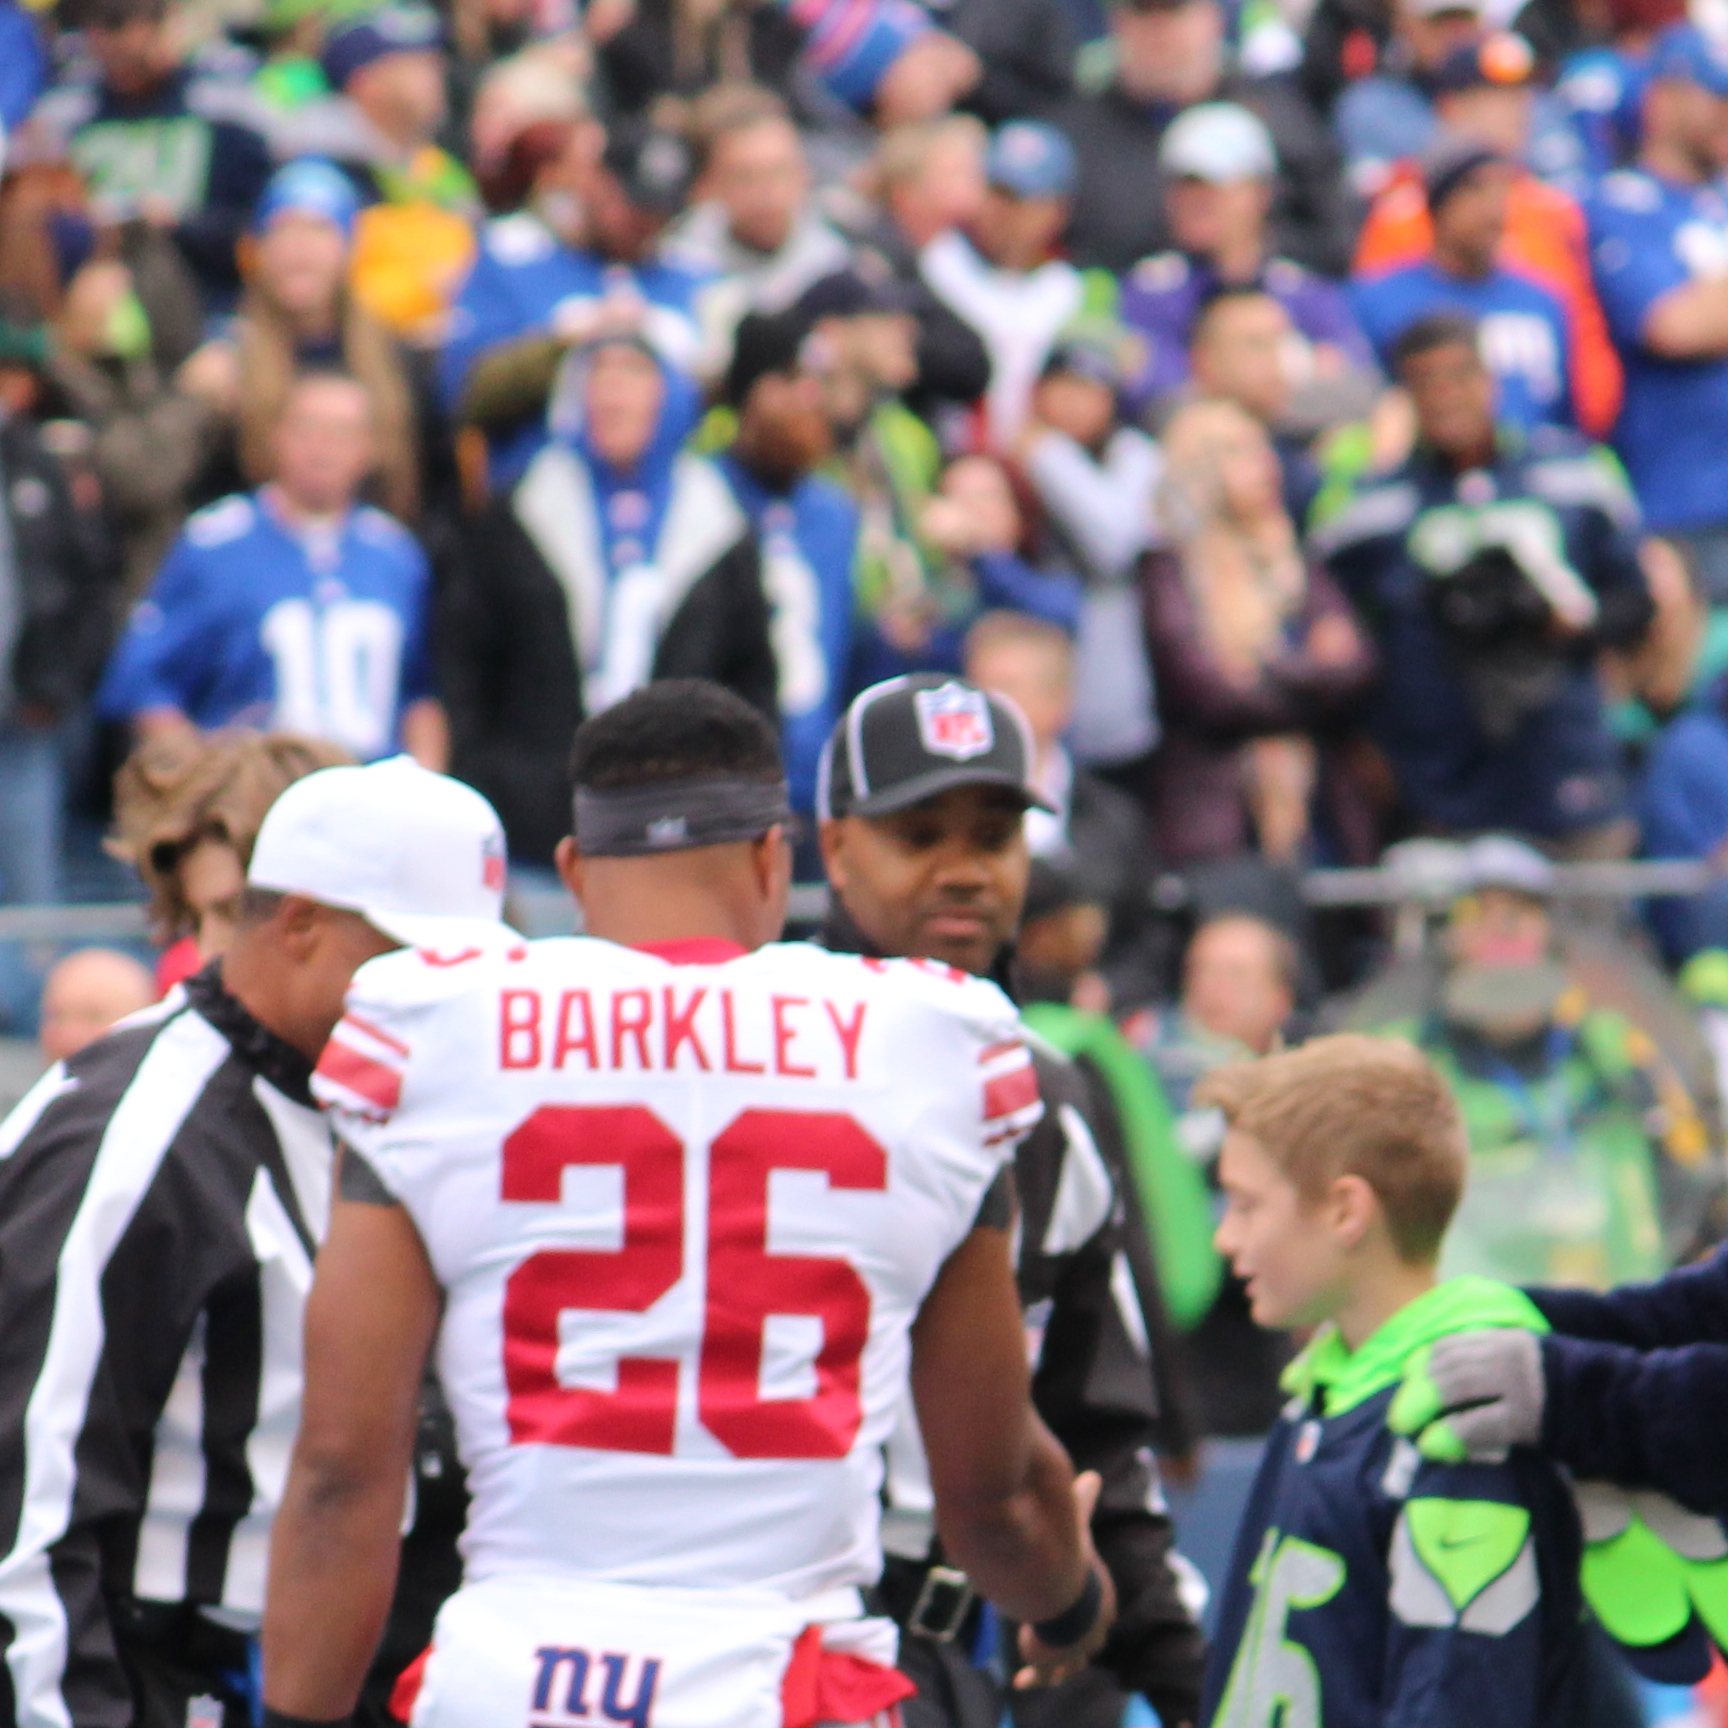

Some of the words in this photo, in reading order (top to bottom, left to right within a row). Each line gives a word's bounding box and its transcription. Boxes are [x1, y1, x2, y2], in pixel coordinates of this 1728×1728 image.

[259, 598, 403, 752] 10
[500, 985, 867, 1081] BARKLEY
[498, 1102, 888, 1461] 26
